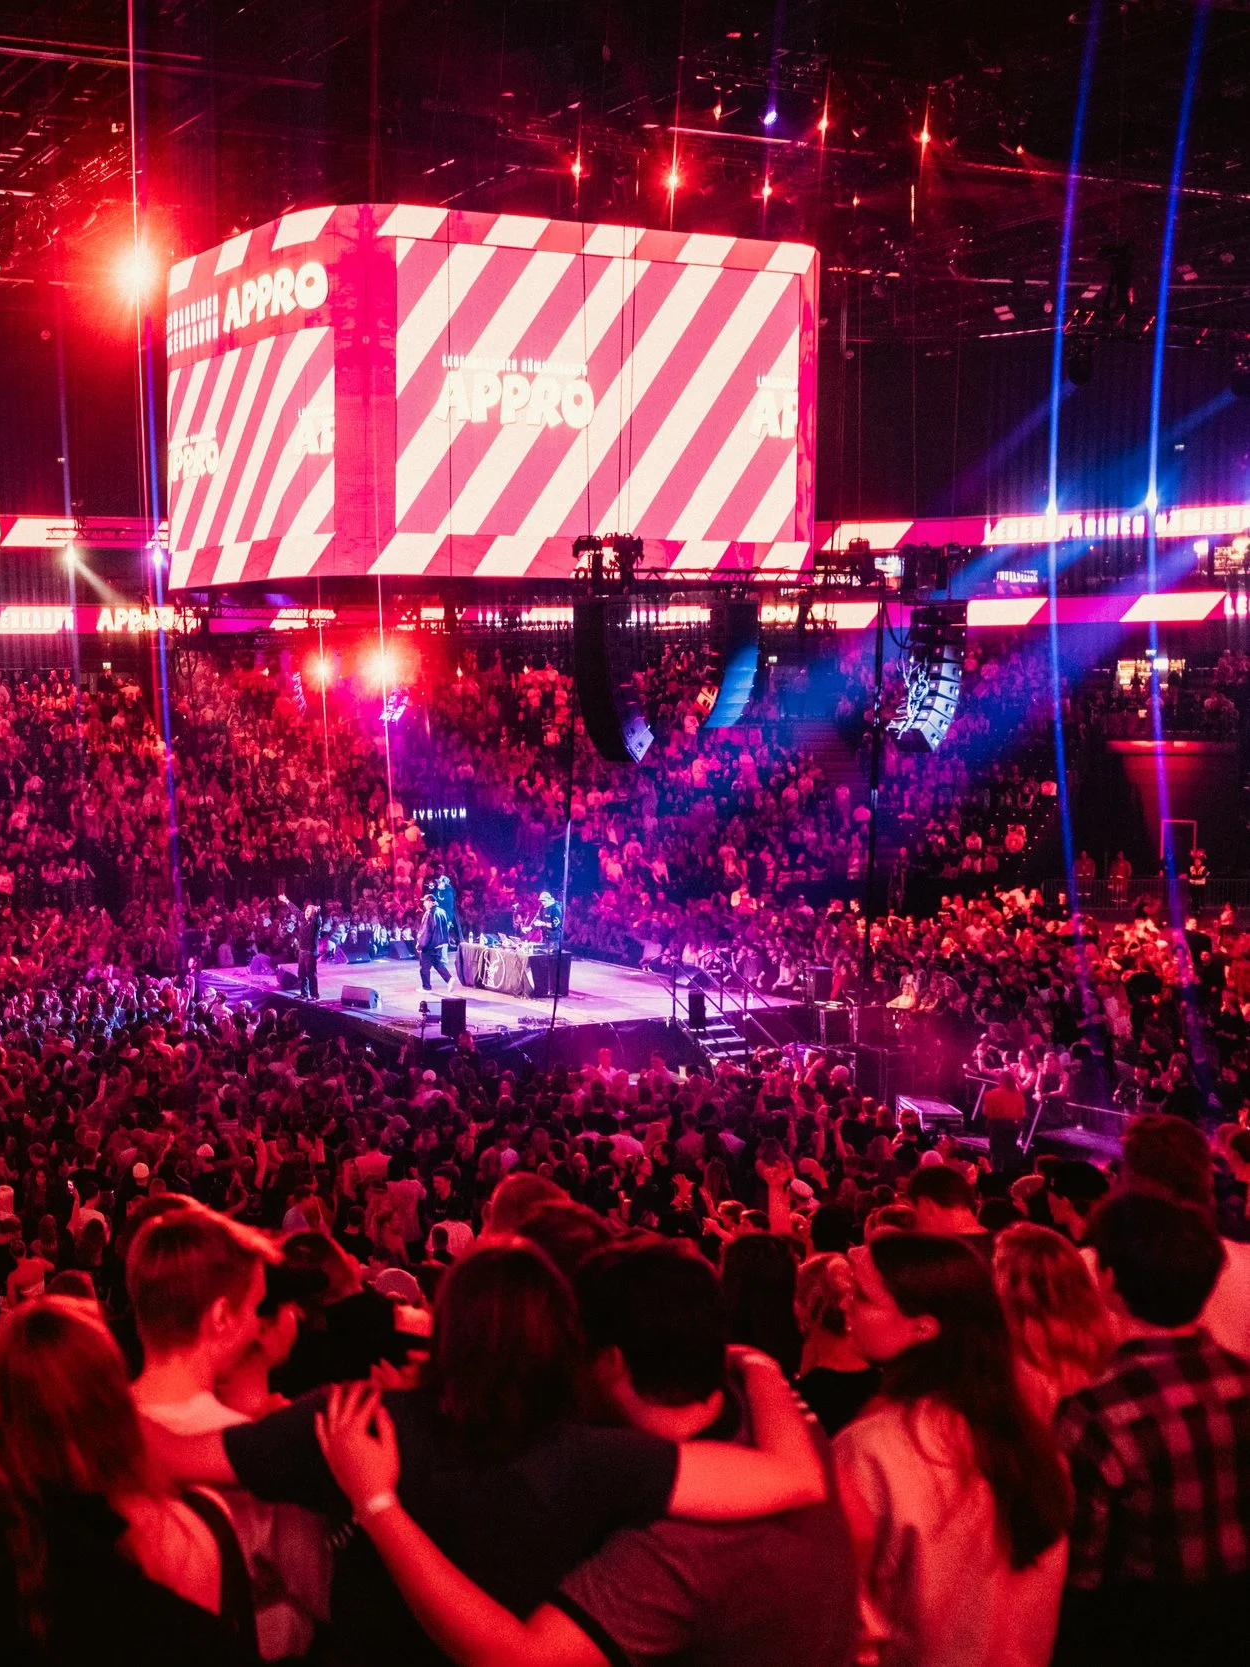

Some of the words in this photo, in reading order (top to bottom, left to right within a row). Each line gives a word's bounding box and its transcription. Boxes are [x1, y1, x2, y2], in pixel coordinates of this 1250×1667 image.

[223, 262, 328, 334] APPRO
[435, 371, 594, 430] APPRO
[1224, 594, 1250, 615] LE
